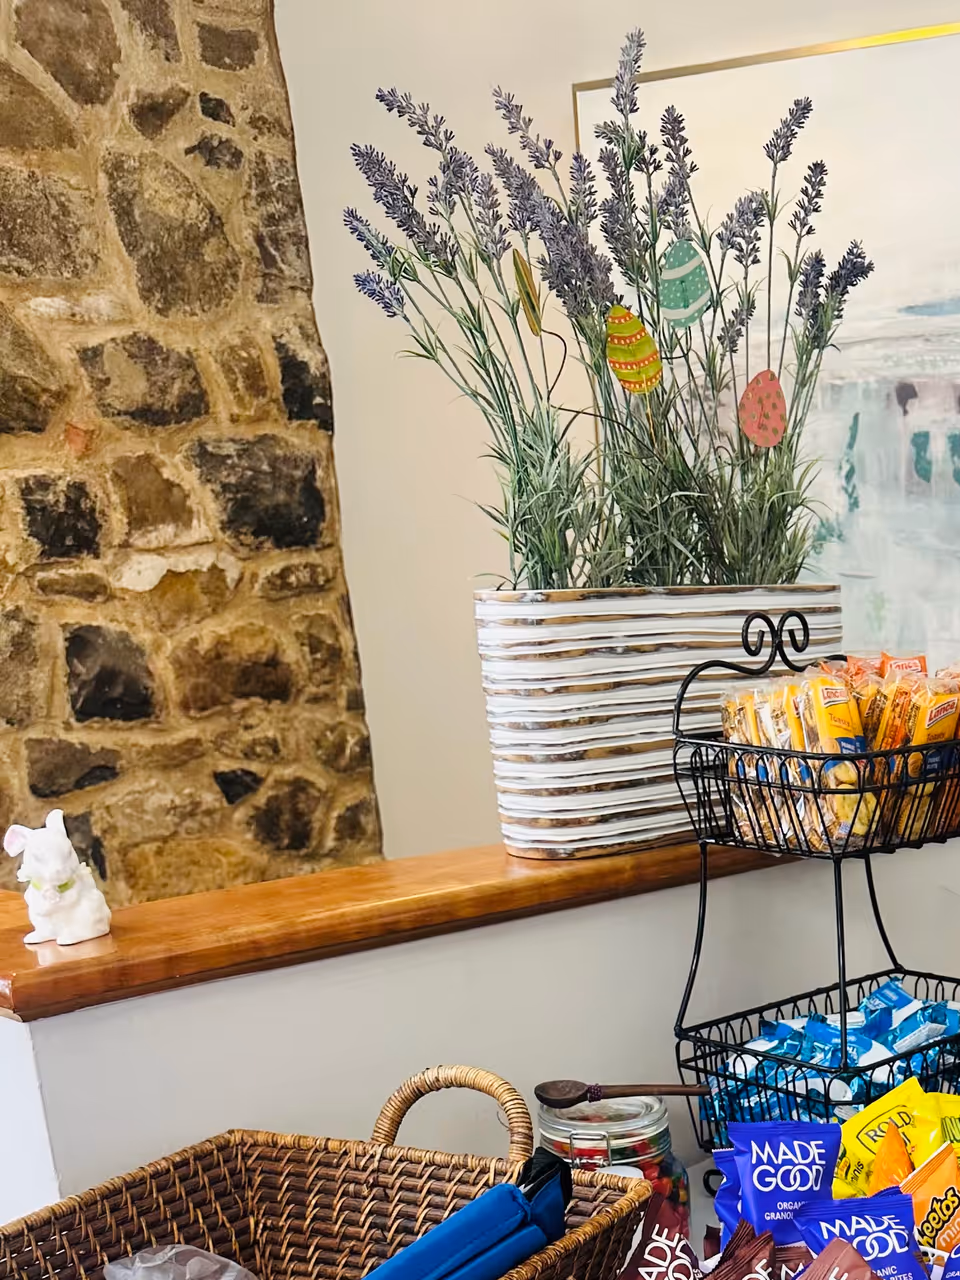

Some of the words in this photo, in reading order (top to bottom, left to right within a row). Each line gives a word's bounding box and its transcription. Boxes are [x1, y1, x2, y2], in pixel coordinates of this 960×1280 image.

[928, 701, 957, 724] Lance
[751, 1140, 826, 1164] MADE
[752, 1165, 824, 1192] GOOD
[819, 1214, 906, 1240] MADE
[852, 1229, 910, 1261] OOD
